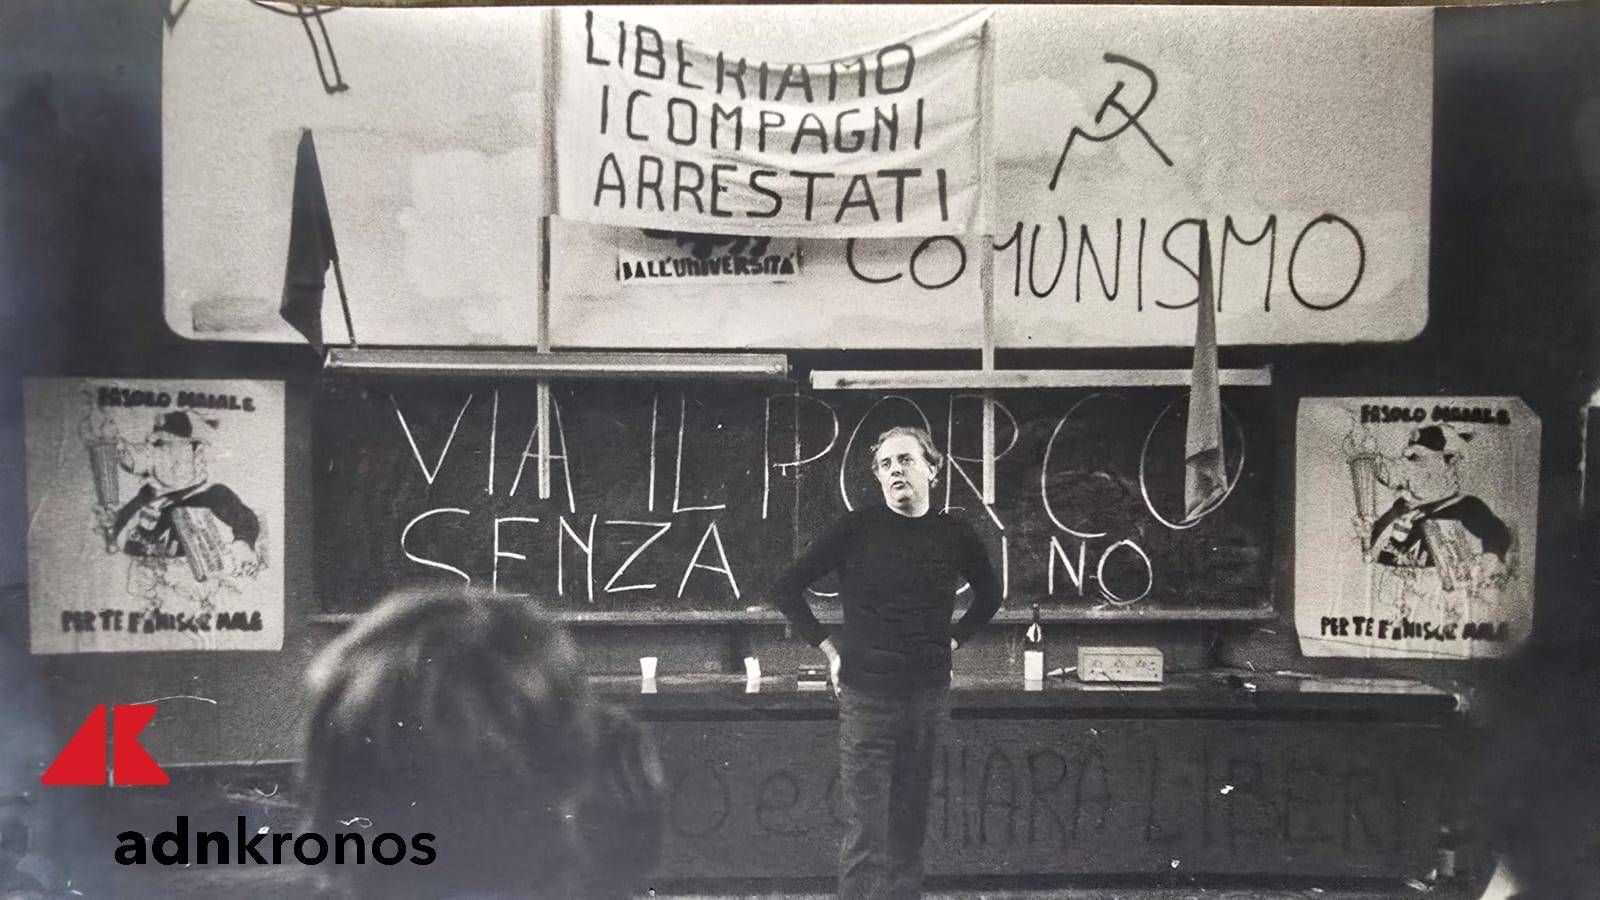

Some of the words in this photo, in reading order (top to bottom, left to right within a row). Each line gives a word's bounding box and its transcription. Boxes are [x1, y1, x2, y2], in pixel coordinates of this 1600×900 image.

[585, 9, 916, 102] LIBERIAMO
[593, 152, 949, 223] ARRESTATI
[389, 388, 576, 513] VIA
[648, 396, 727, 513] IL
[761, 392, 1226, 530] PORCO
[401, 508, 741, 603] SENZA
[1321, 616, 1349, 637] PER
[1352, 616, 1374, 637] TE
